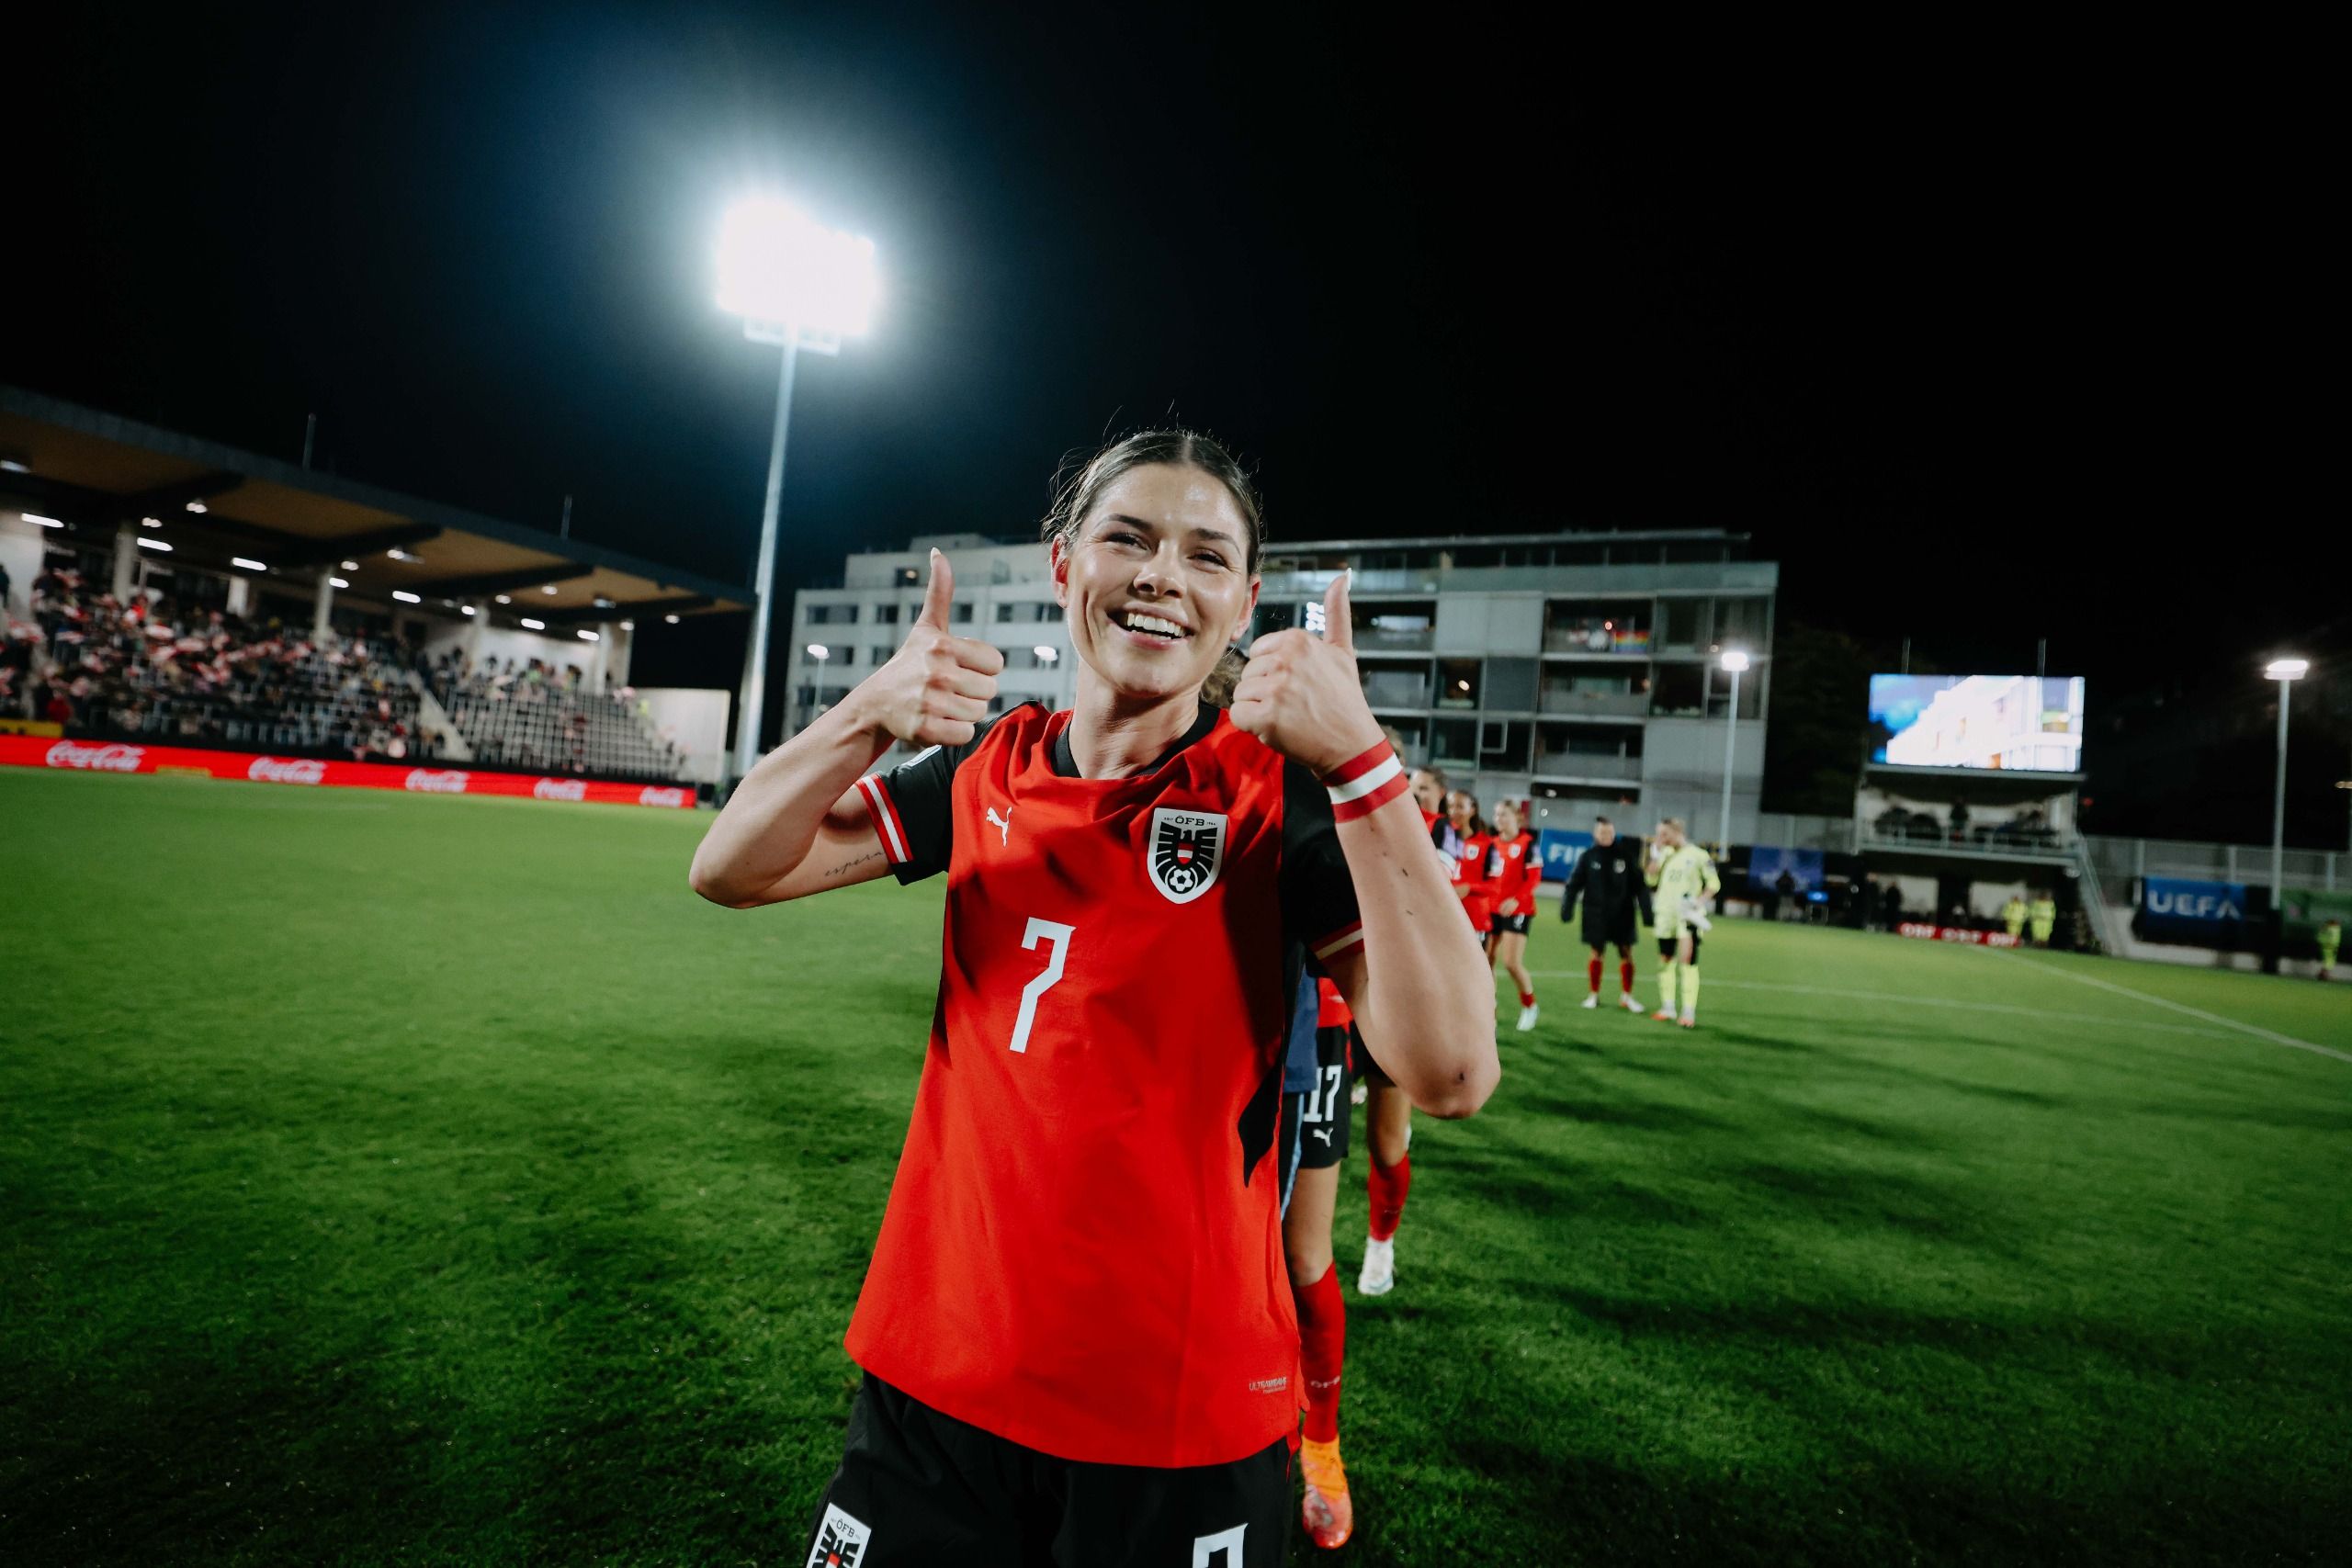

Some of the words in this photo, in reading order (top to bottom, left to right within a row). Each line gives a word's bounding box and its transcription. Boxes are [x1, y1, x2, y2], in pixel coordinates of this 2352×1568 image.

[46, 739, 146, 773] Coca-Cola
[1175, 815, 1204, 826] ÖFB
[2147, 889, 2241, 920] UEFA
[1010, 917, 1077, 1054] 7
[1304, 1065, 1342, 1122] 17
[836, 1518, 855, 1538] ÖFB
